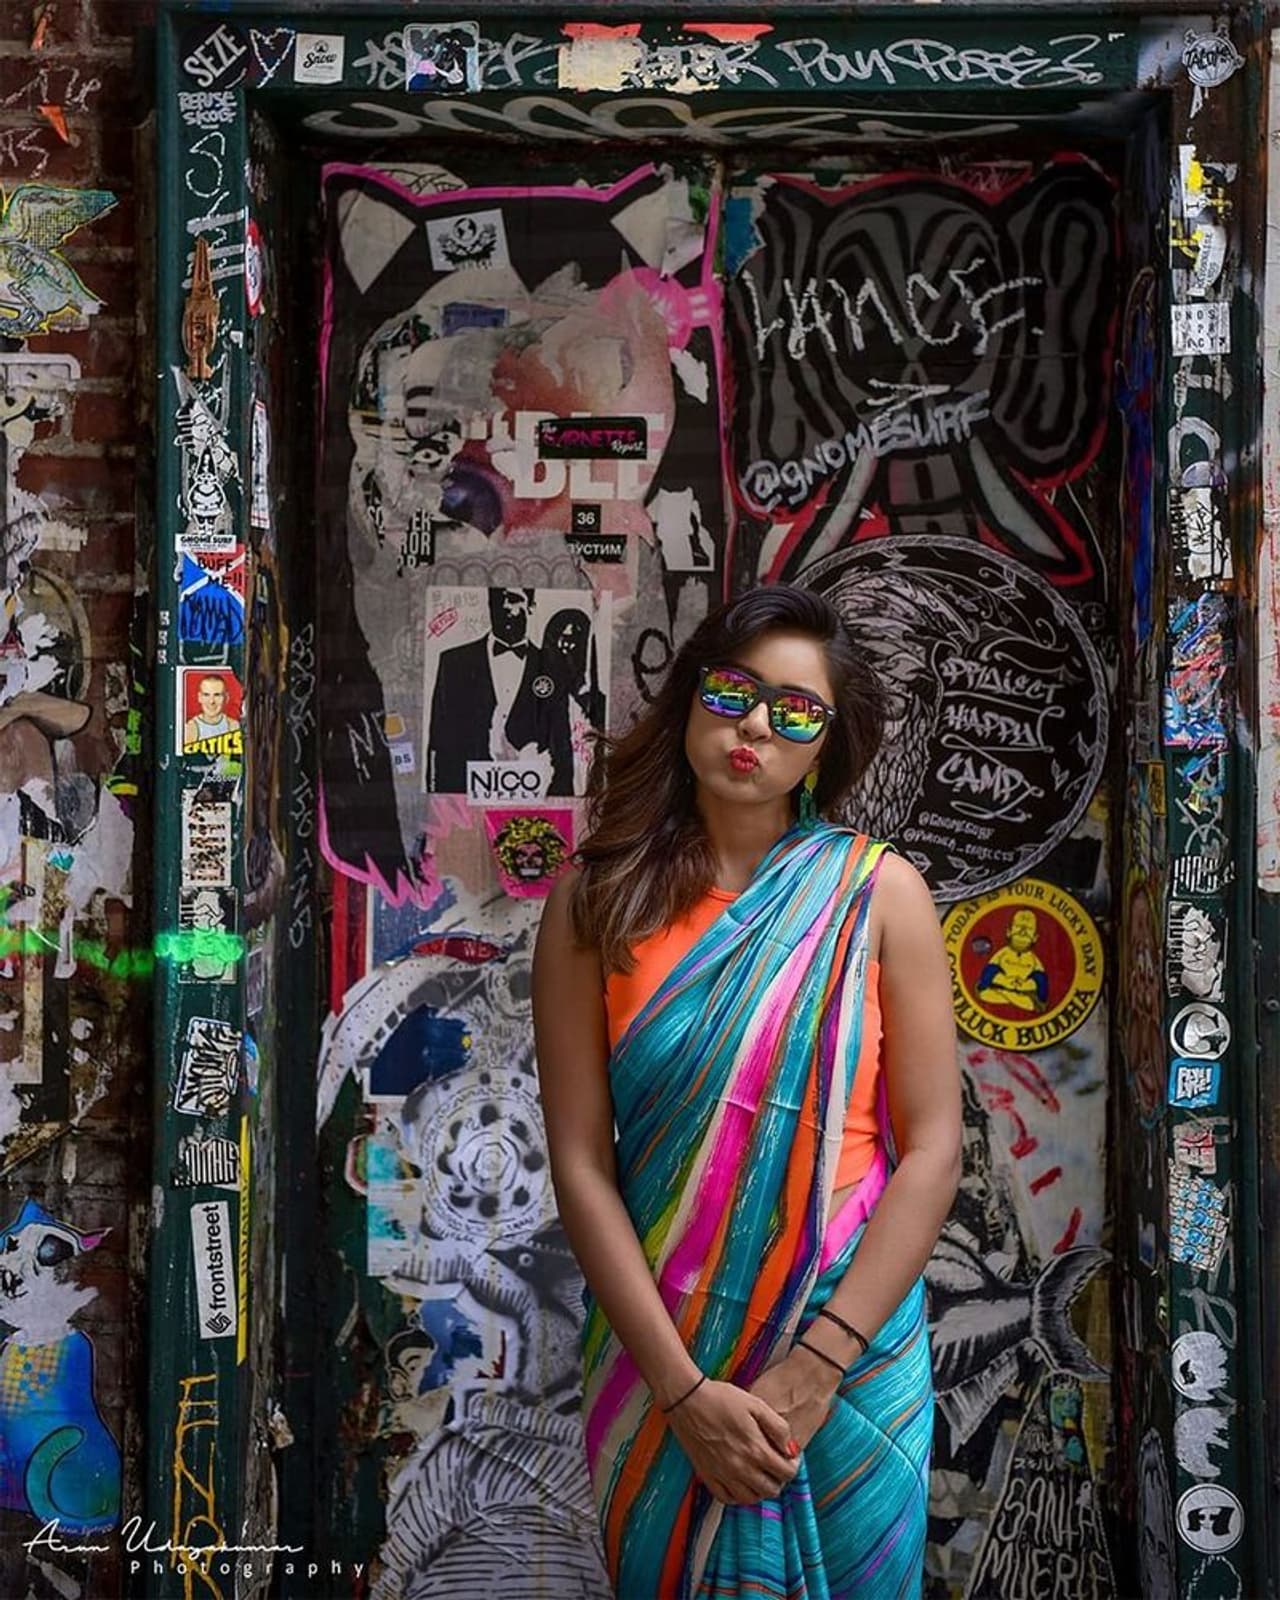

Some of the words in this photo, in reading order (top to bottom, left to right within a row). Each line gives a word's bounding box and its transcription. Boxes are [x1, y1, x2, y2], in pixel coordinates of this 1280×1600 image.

[184, 24, 247, 88] SEZE
[303, 53, 337, 69] Snow
[740, 389, 991, 513] @GNOMESURF
[213, 535, 233, 544] SURF
[577, 511, 596, 525] 36
[183, 731, 243, 754] CELTICS
[946, 899, 983, 945] TODAY
[1006, 882, 1045, 900] YOUR
[1049, 894, 1089, 937] LUCKY
[1081, 941, 1098, 977] DAY
[955, 1004, 1009, 1045] LUCK
[1015, 989, 1095, 1047] BUDDHA
[208, 1203, 222, 1310] frontstreet
